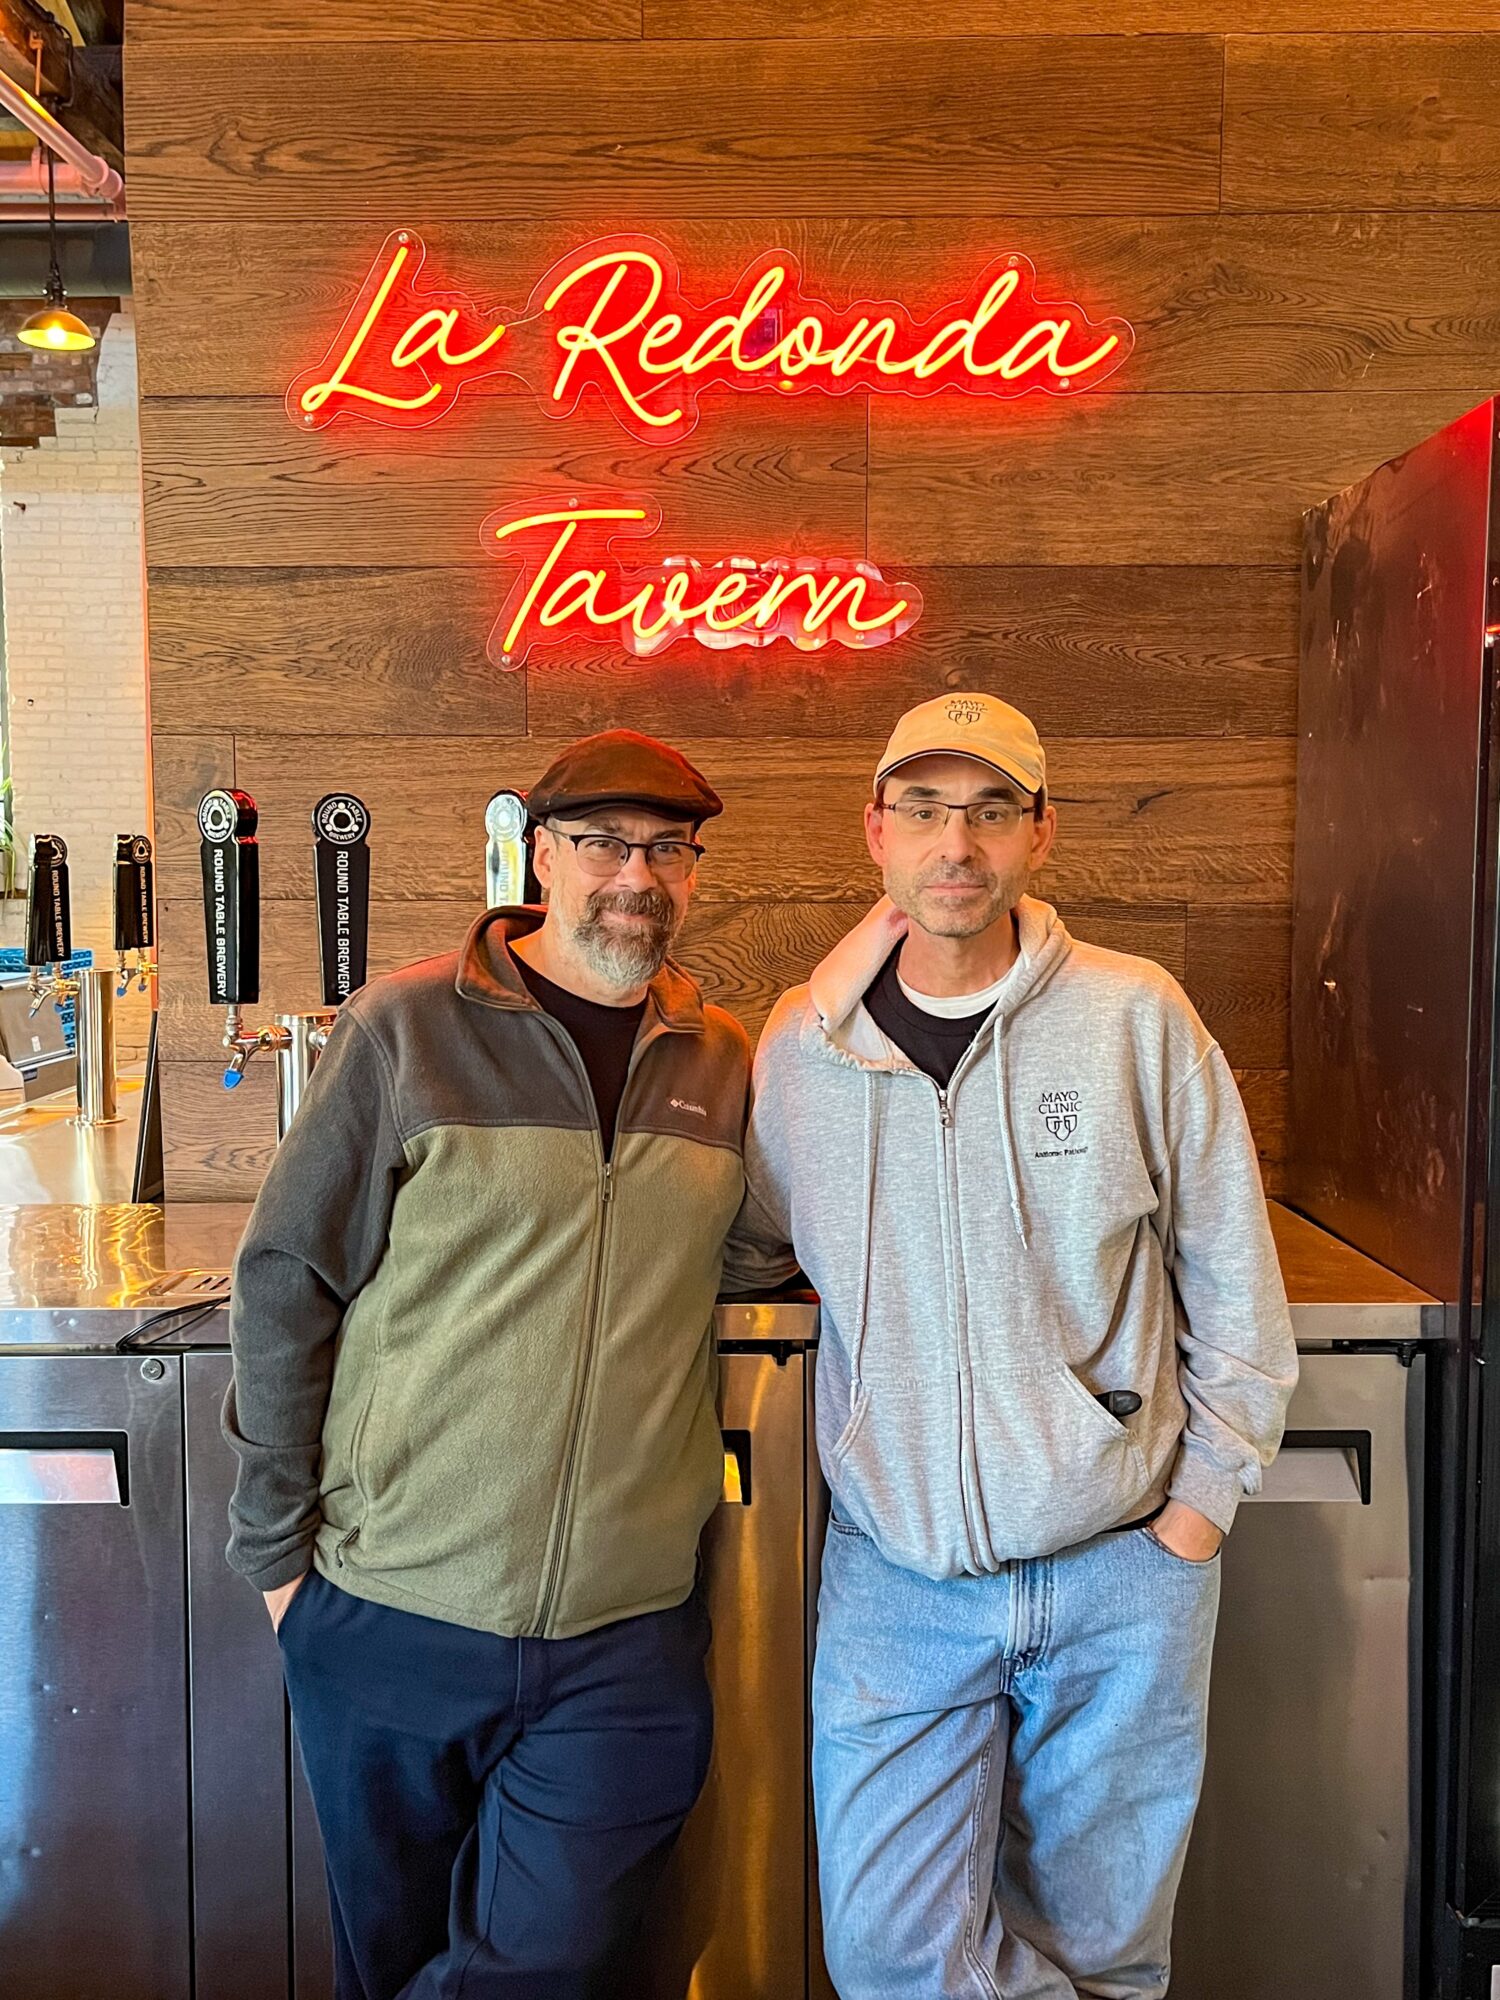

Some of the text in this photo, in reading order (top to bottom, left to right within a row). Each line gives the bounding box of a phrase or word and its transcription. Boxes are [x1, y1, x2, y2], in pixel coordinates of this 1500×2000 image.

[301, 247, 1119, 428] La Redonda
[496, 509, 908, 652] Tavern
[321, 801, 338, 824] ROUND
[51, 869, 60, 897] ROUND
[53, 897, 62, 921] TABLE
[213, 848, 227, 997] ROUND TABLE BREWERY
[336, 850, 350, 998] ROUND TABLE BREWERY
[55, 921, 65, 957] BREWERY
[1038, 1100, 1083, 1115] CLINIC
[1041, 1090, 1079, 1103] MAYO
